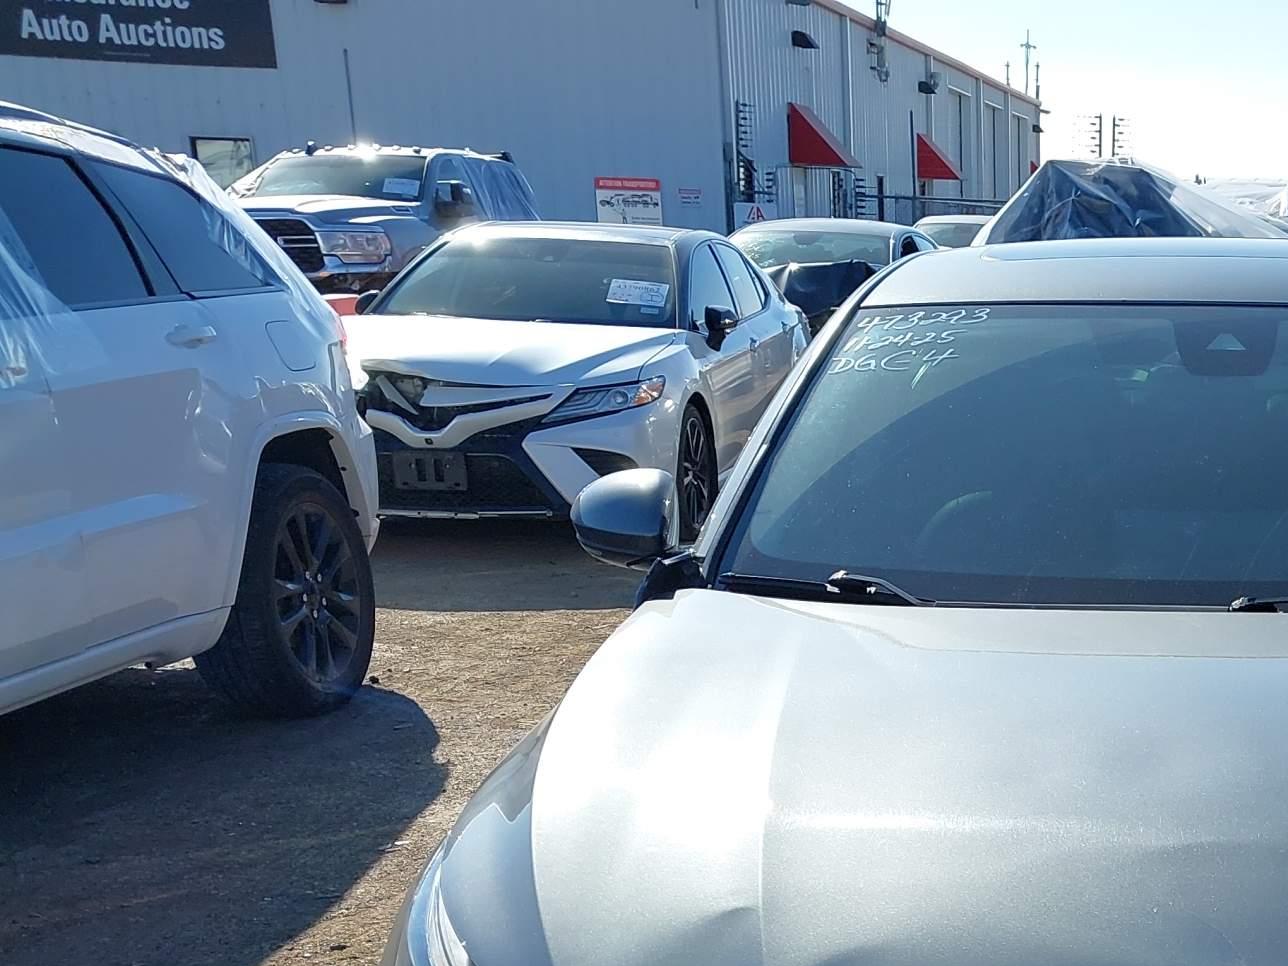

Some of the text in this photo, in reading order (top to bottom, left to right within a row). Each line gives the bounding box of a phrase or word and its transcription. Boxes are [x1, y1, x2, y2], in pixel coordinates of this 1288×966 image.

[21, 8, 225, 50] Auto Auctions
[856, 308, 991, 333] 473293
